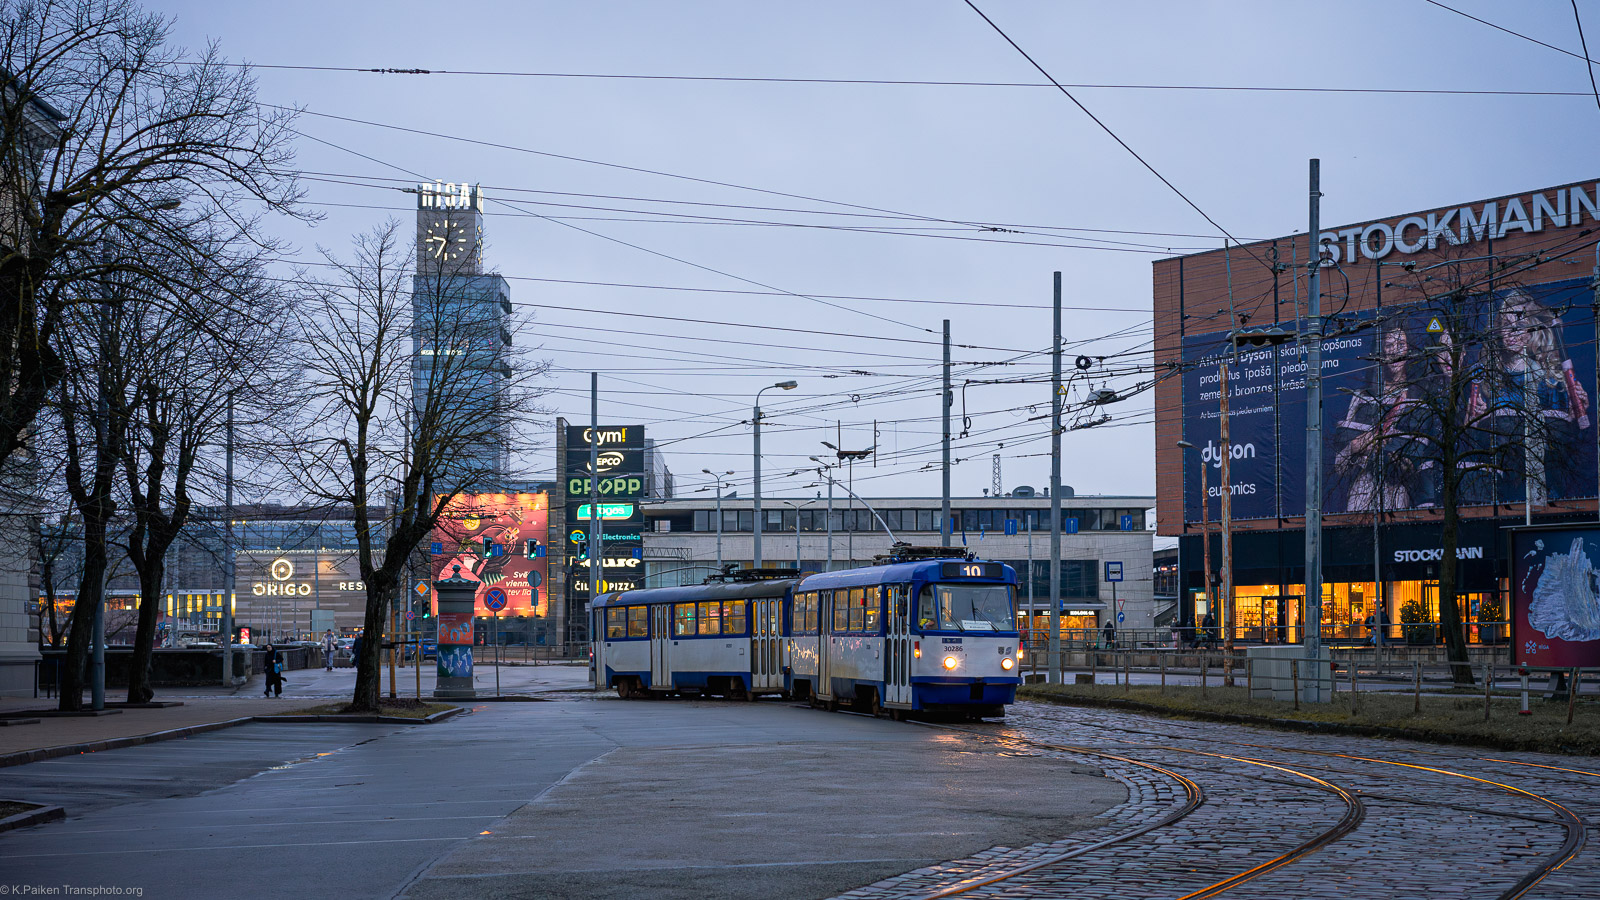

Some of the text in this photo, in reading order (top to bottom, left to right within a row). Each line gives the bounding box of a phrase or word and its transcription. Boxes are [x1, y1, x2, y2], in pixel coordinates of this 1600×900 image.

[1318, 183, 1600, 268] STOCKMANN
[1245, 365, 1271, 381] īpašā
[1235, 384, 1273, 397] bronzas
[596, 457, 621, 466] EPCO
[1394, 546, 1483, 562] STOCKANN
[963, 565, 981, 577] 10
[252, 583, 312, 596] ORIGO
